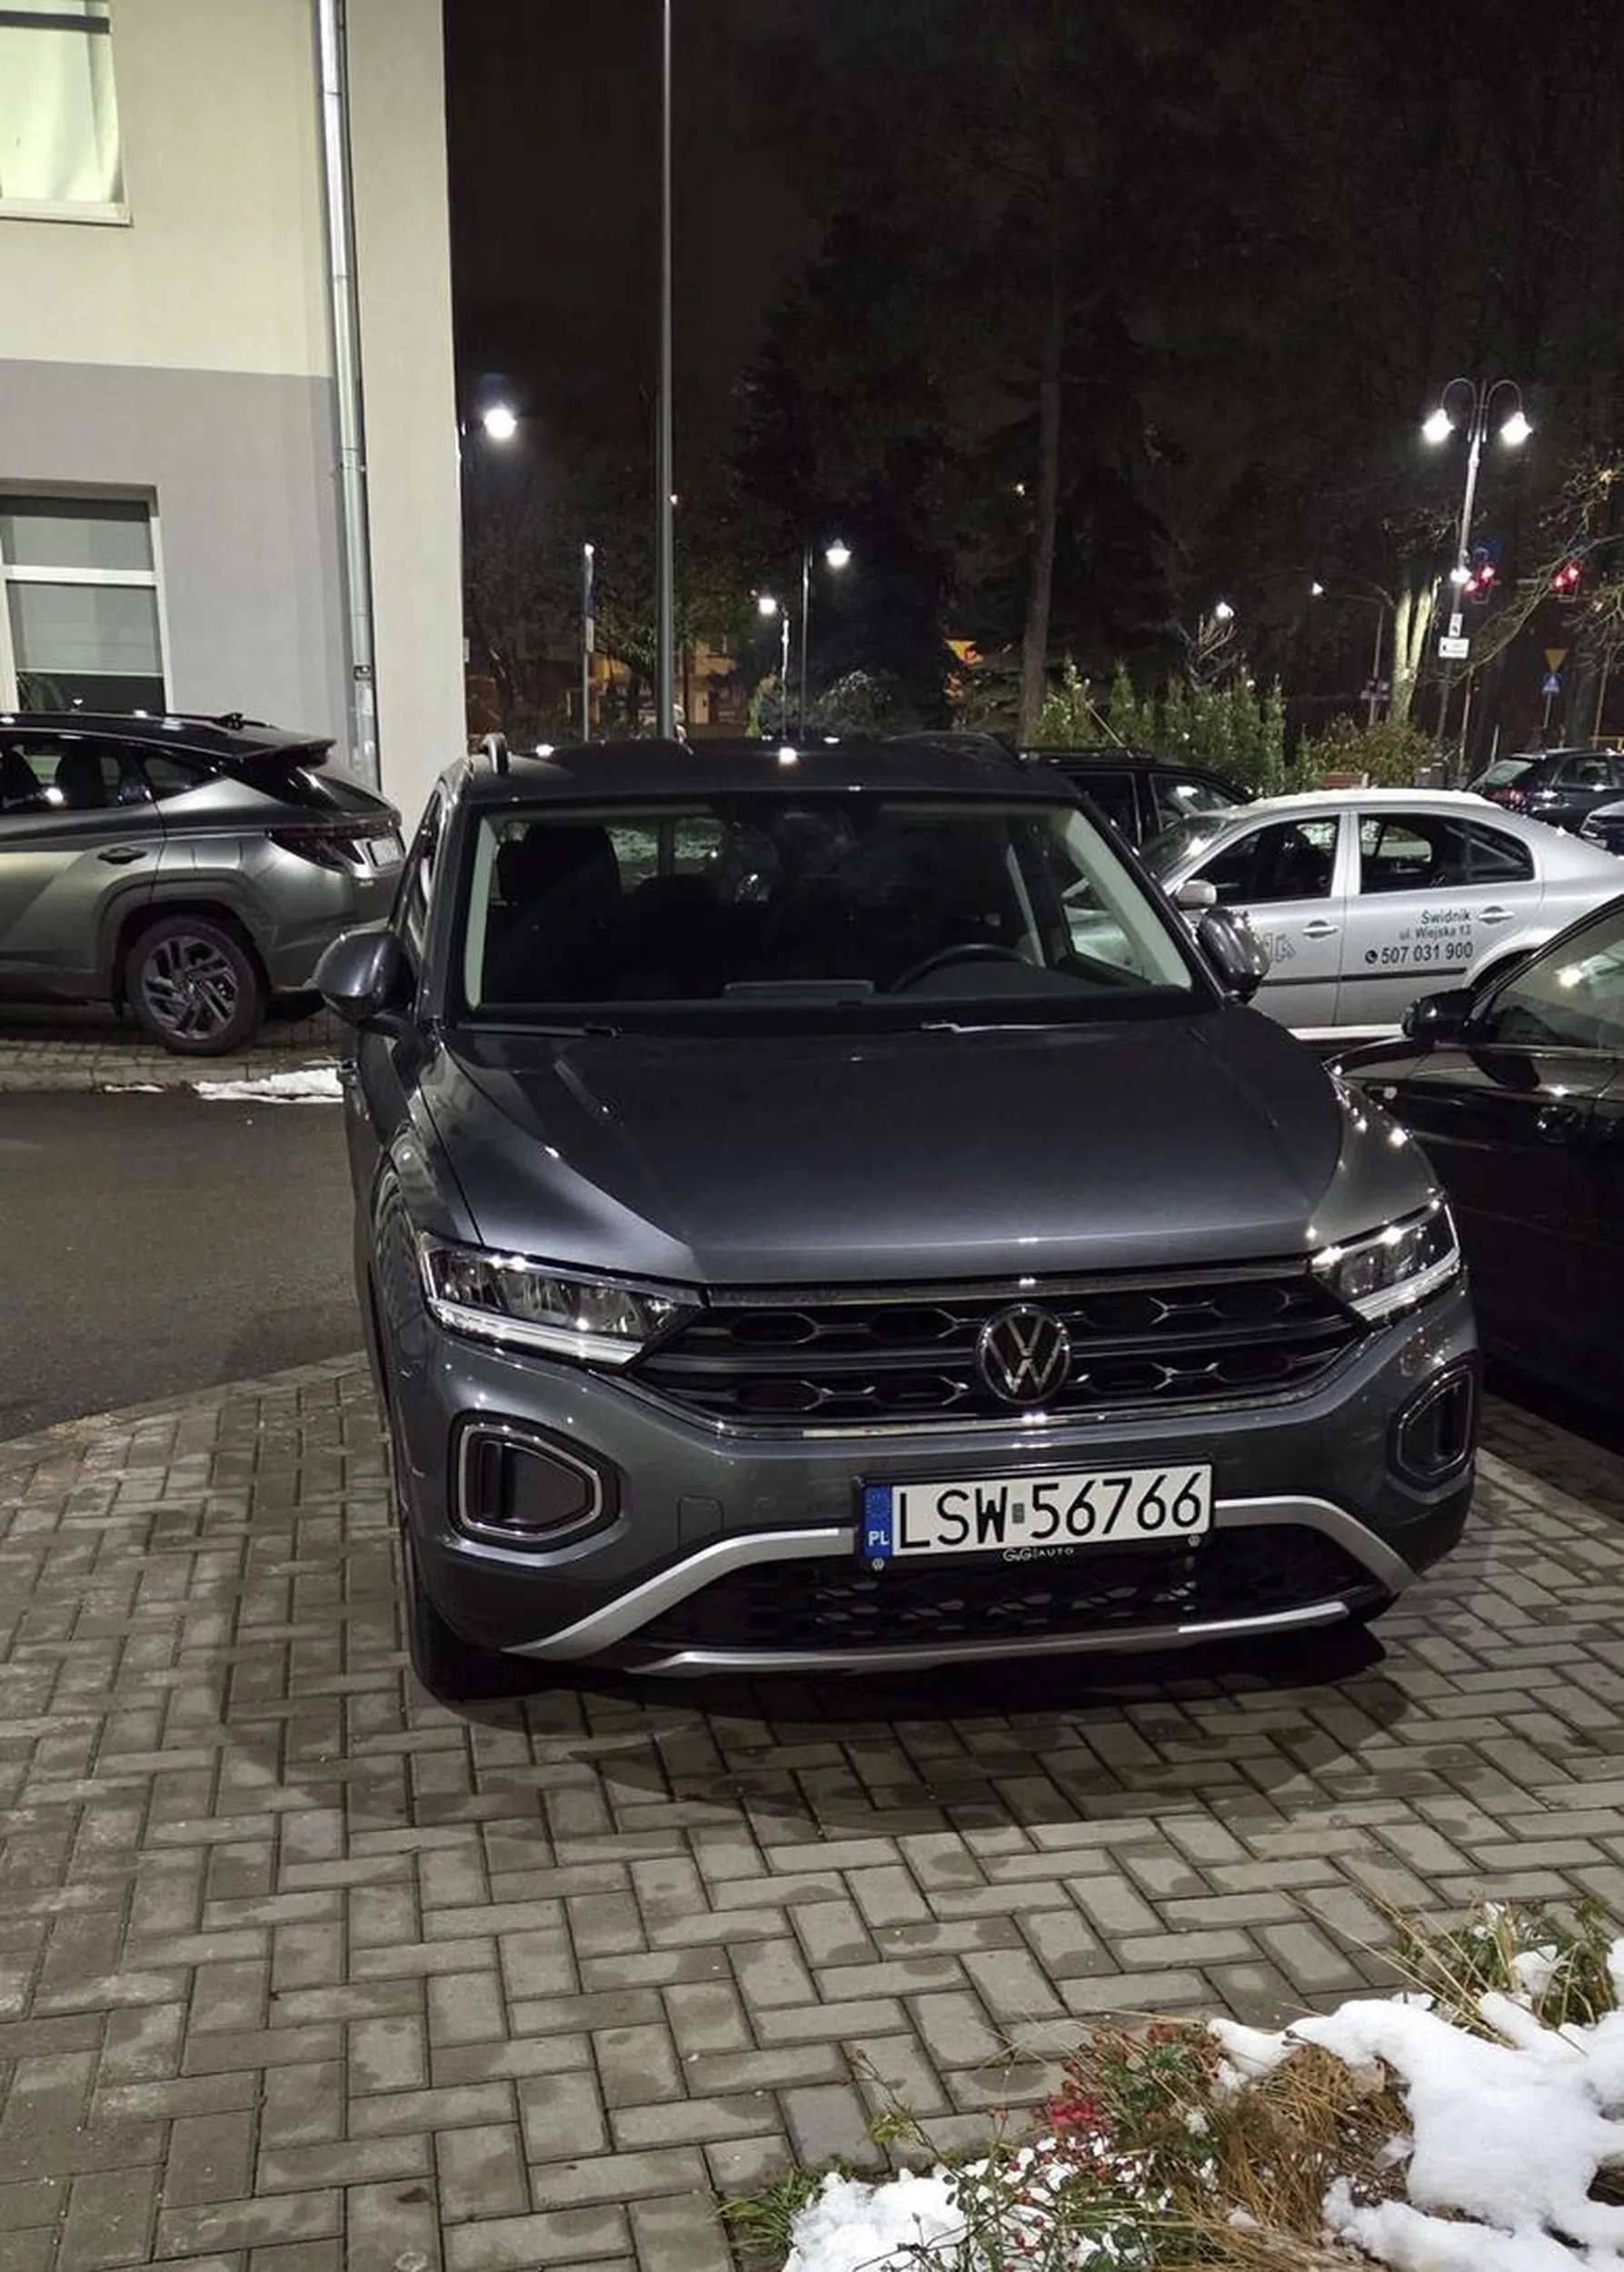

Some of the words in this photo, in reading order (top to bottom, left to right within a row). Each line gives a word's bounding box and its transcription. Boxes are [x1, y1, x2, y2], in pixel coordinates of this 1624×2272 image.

[1380, 946, 1409, 964] 507
[1413, 944, 1440, 962] 031
[1445, 942, 1472, 960] 900
[900, 1487, 1008, 1549] LSW
[1030, 1471, 1203, 1540] 56766
[868, 1530, 890, 1546] PL
